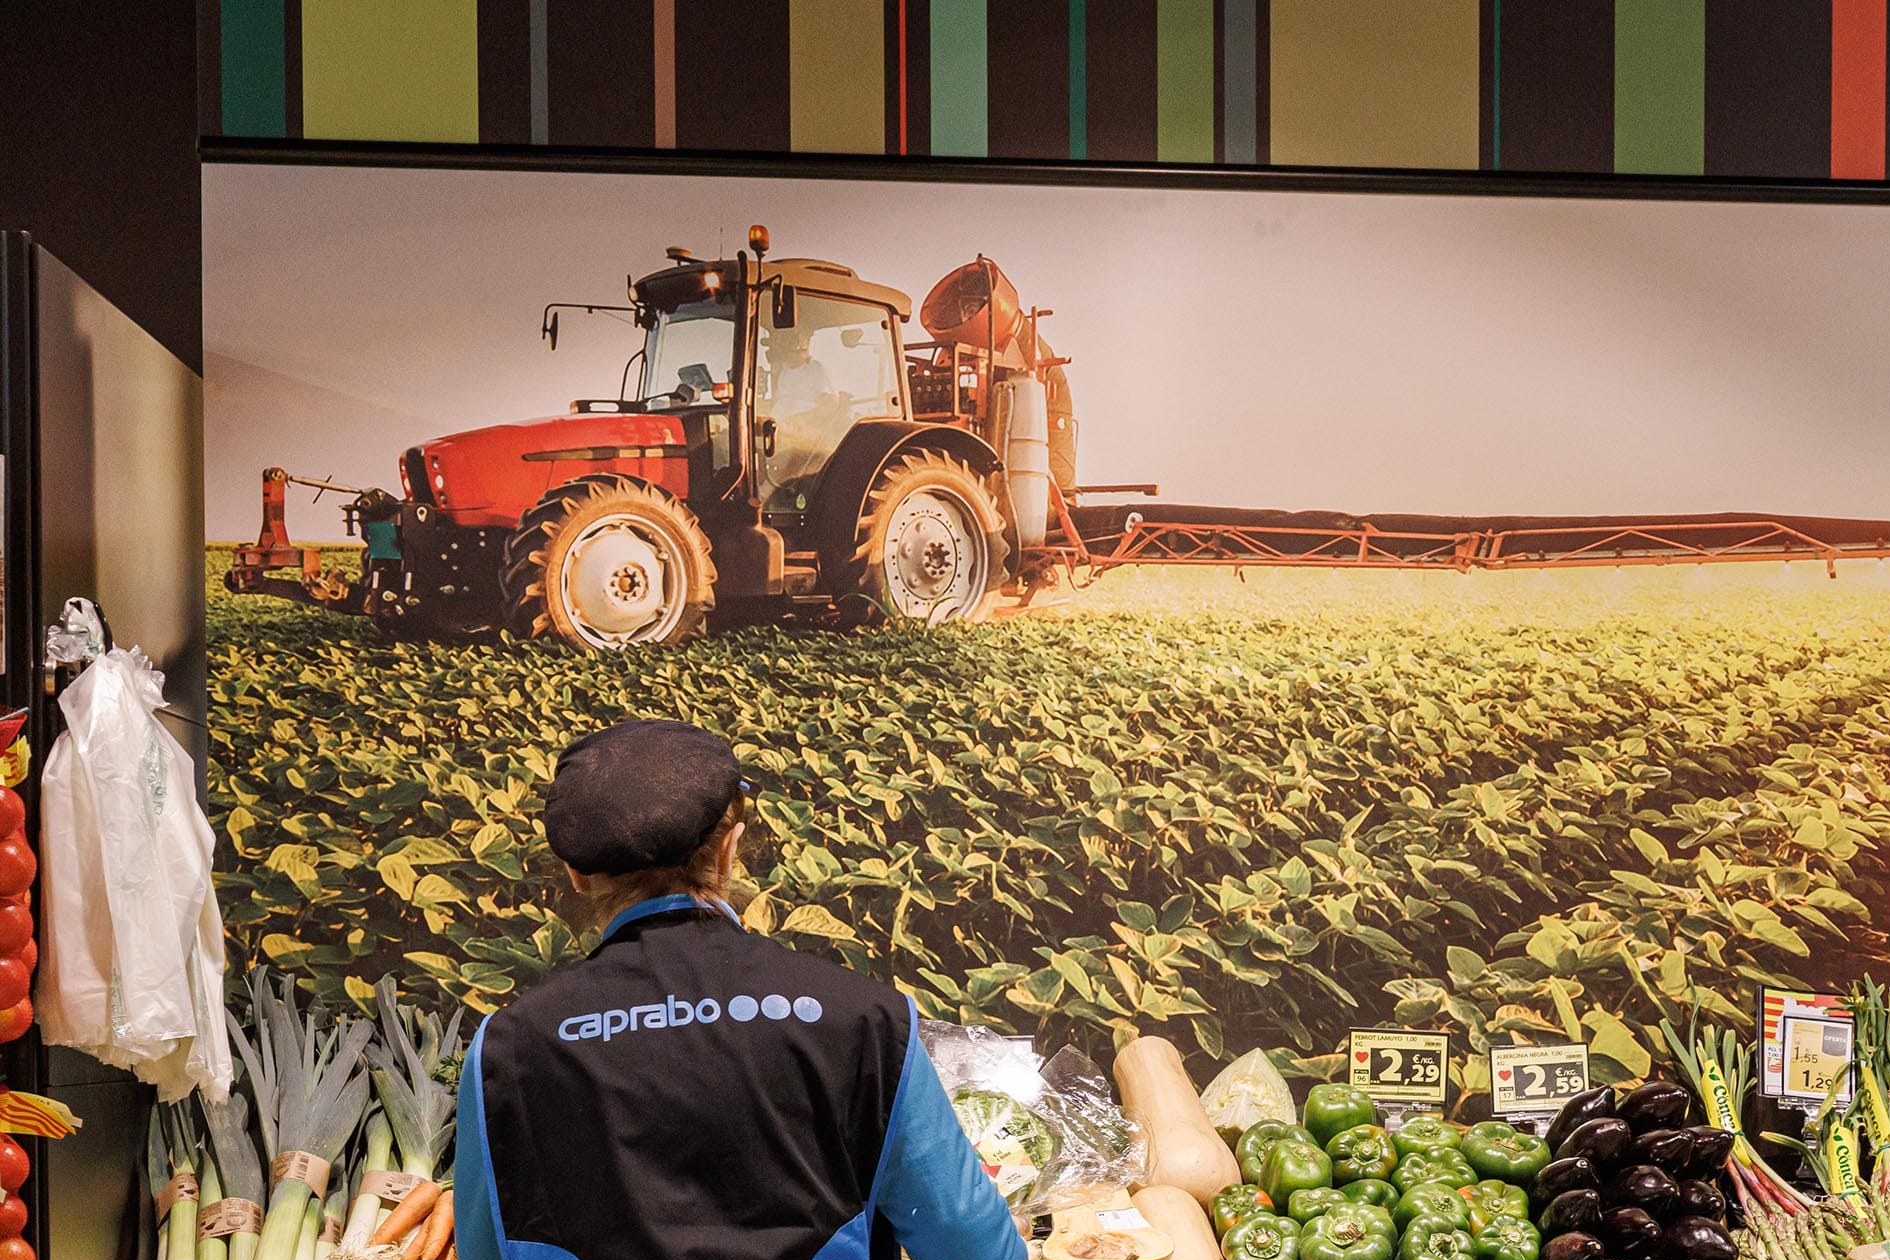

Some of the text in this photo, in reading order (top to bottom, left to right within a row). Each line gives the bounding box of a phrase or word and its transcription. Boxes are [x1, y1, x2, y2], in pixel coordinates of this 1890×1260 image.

[558, 994, 721, 1041] caprabo
[1355, 1034, 1377, 1042] PEBROT
[1357, 1075, 1367, 1083] 96
[1378, 1048, 1440, 1085] 2,29
[1803, 1069, 1834, 1090] 1,29
[1522, 1065, 1584, 1098] 2,59
